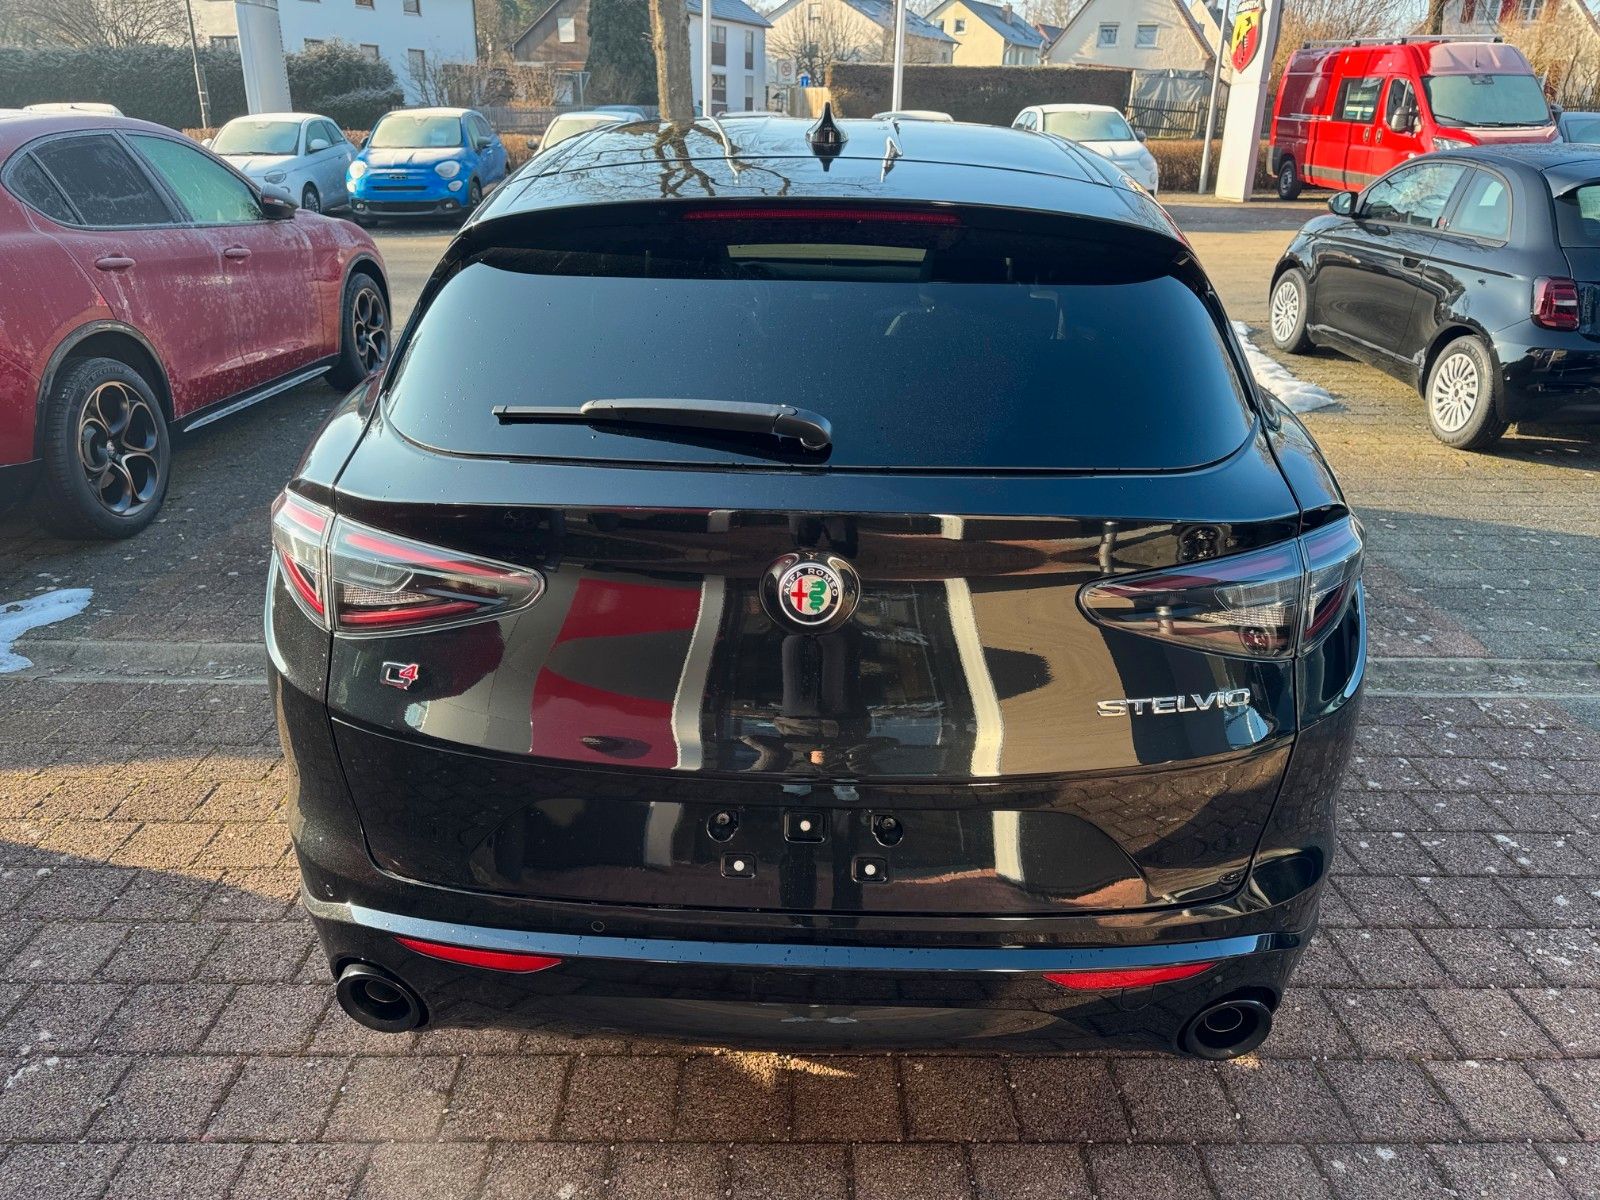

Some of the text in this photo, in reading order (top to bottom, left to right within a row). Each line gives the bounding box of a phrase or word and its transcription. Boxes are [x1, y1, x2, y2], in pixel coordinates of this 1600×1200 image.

[784, 568, 839, 597] ALFA ROMEO
[380, 661, 419, 690] Q4
[1097, 688, 1251, 717] STELVIO
